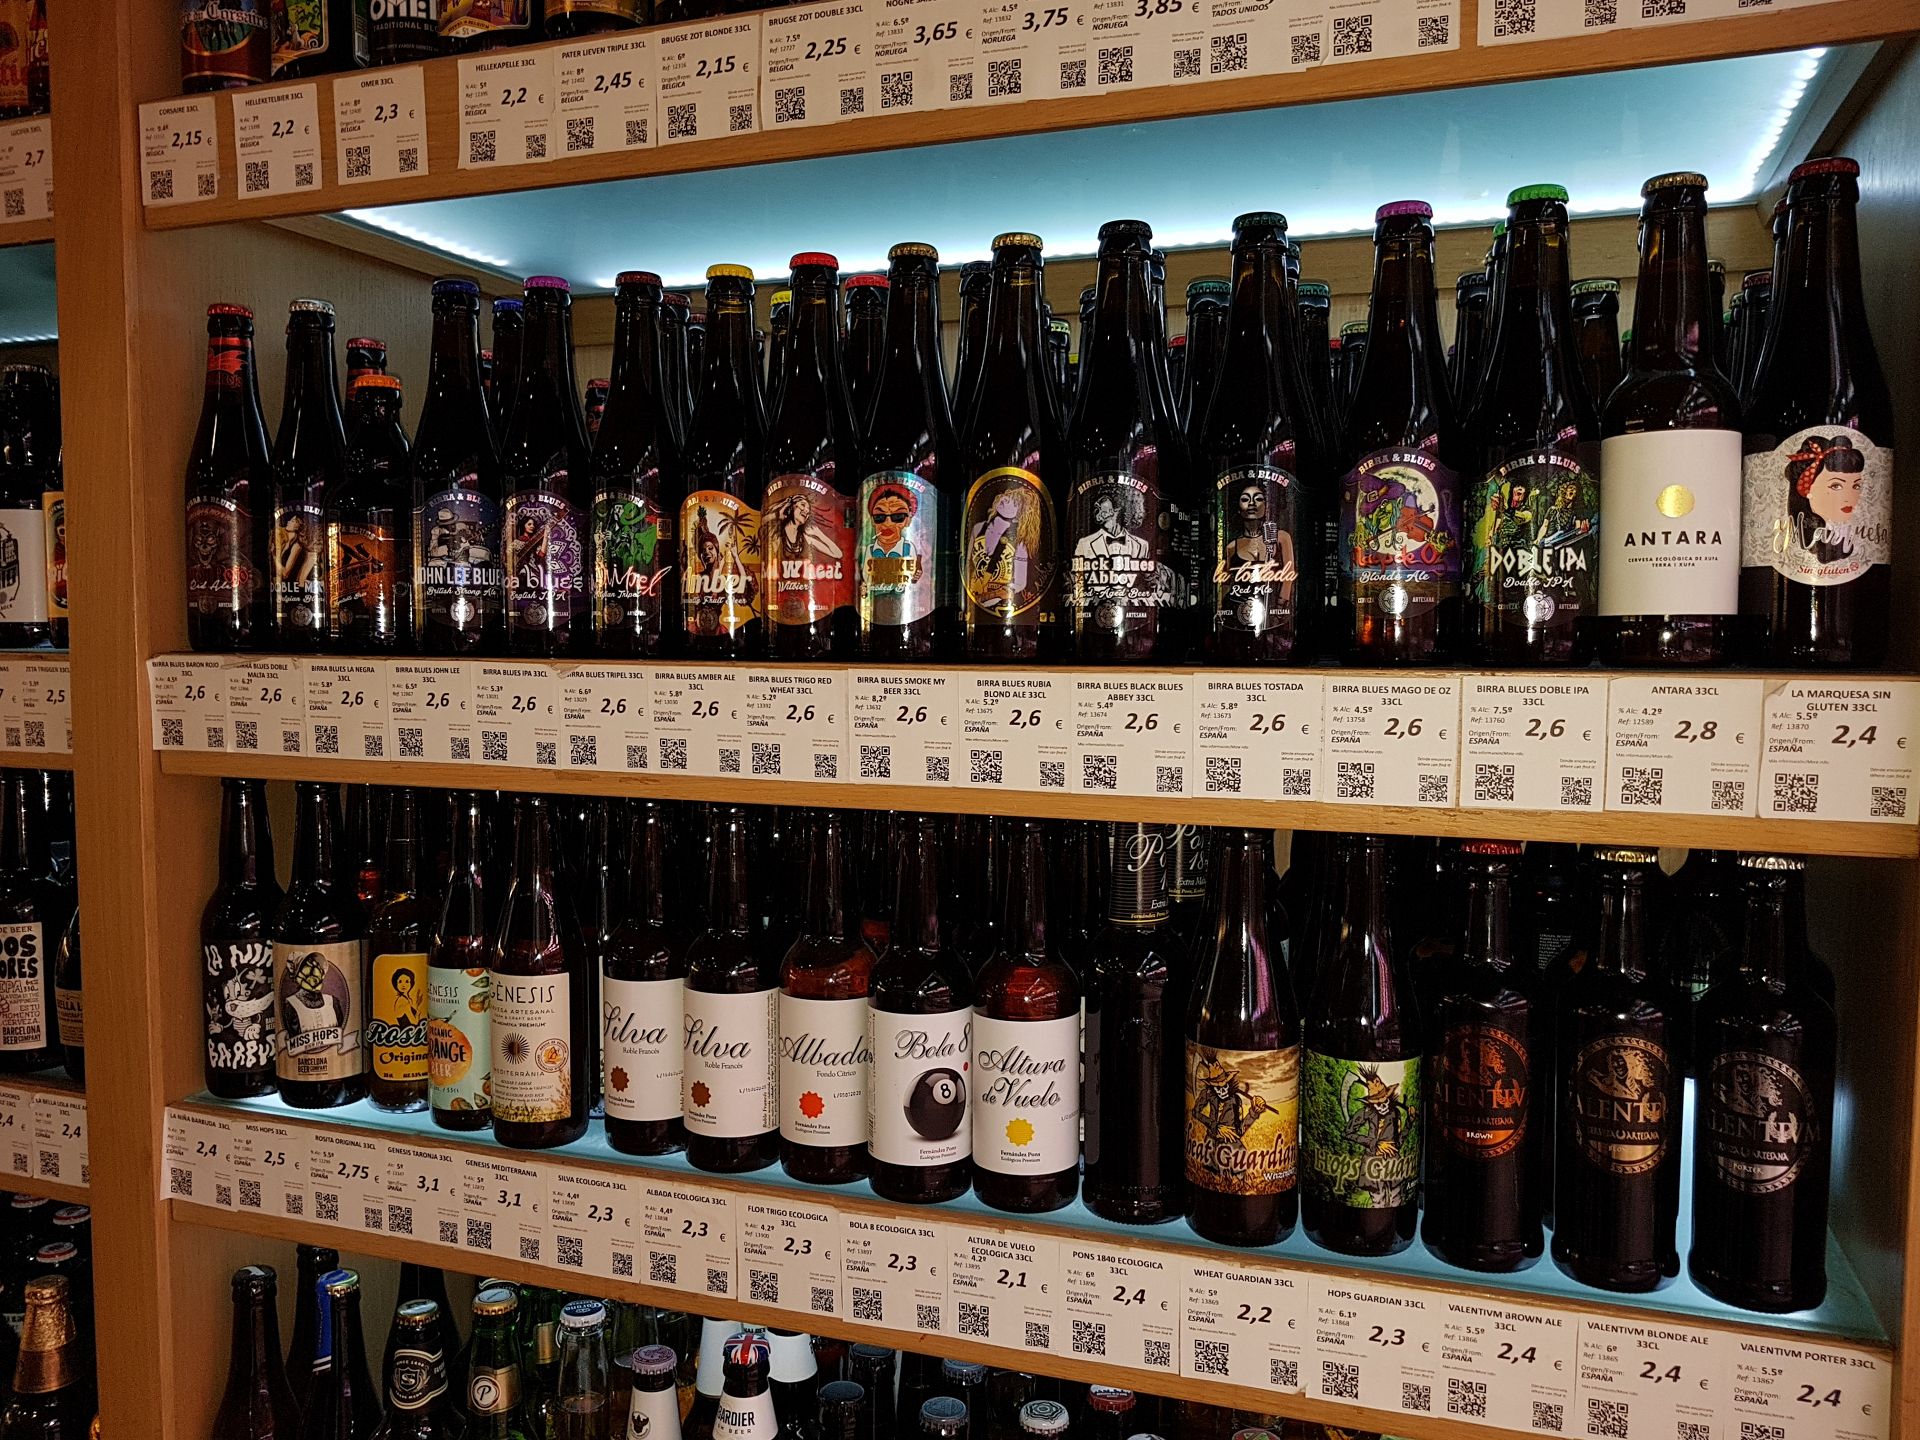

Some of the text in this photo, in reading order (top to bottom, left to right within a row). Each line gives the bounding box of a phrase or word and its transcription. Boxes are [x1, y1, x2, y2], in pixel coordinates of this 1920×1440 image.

[769, 5, 863, 26] BRUGSE ZOT DOUBLE 33CL
[1022, 8, 1068, 32] 3,75
[374, 21, 421, 32] TRADITIONAL
[661, 24, 751, 44] BRUGSE ZOT BLONDE 33CL
[913, 21, 958, 44] 3,65
[562, 41, 646, 59] PATER LIEVEN TRIPLE 33CL
[805, 37, 861, 61] 2,25 €
[875, 47, 908, 57] NORUEGA
[696, 56, 736, 78] 2,15
[361, 77, 394, 88] OMER 33CL
[594, 71, 632, 93] 2,45
[374, 104, 398, 121] 2,3
[172, 131, 202, 148] 2,15
[25, 150, 44, 167] 2,7
[1500, 454, 1581, 476] BIRRA & BLUES
[1077, 475, 1148, 495] BIRRA & BLUES
[1624, 531, 1722, 547] ANTARA
[1072, 556, 1154, 572] Black Blues
[1490, 545, 1587, 576] DOBLE IPA
[782, 561, 842, 580] Wheat
[1359, 571, 1430, 582] Blonde Ale
[1797, 566, 1849, 577] Sin gluten
[483, 668, 501, 676] BIRRA
[534, 670, 548, 678] 33CL
[881, 677, 902, 685] BLUES
[904, 677, 929, 685] SMOKE
[931, 678, 945, 686] MY
[903, 688, 921, 696] 33CL
[1077, 682, 1183, 692] BIRRA BLUES BLACK BLUES
[1208, 683, 1303, 692] BIRRA BLUES TOSTADA
[1391, 686, 1451, 695] MAGO DE OZ
[1651, 686, 1719, 696] ANTARA 33CL
[1791, 690, 1891, 700] LA MARQUESA SIN
[46, 689, 65, 704] 2,5
[512, 696, 536, 712] 2,6
[1108, 693, 1155, 702] ABBEY 33CL
[1220, 702, 1238, 710] 5.8º
[1641, 706, 1662, 716] 4.2º
[1806, 702, 1878, 712] GLUTEN 33CL
[1124, 713, 1158, 733] 2,6
[1485, 716, 1505, 724] 13760
[1200, 731, 1228, 739] ESPAÑA
[1525, 718, 1591, 741] 2,6 €
[1674, 720, 1717, 743] 2,8
[1831, 725, 1878, 747] 2,4
[1615, 738, 1648, 748] ESPAÑA
[3, 1025, 40, 1035] BARCELONA
[603, 1001, 668, 1044] Silva
[289, 1029, 339, 1049] MISS HOPS
[684, 1013, 751, 1059] Silva
[895, 1022, 971, 1059] Bola 8
[623, 1047, 641, 1055] Roble
[779, 1033, 869, 1066] Albada
[978, 1046, 1065, 1074] Altura
[941, 1083, 951, 1098] 8
[982, 1077, 1060, 1107] de Vuelo
[246, 1124, 288, 1136] MISS HOPS 33CL
[1466, 1131, 1493, 1140] BROWN
[315, 1134, 376, 1150] ROSITA ORIGINAL 33CL
[264, 1150, 286, 1166] 2,5
[1314, 1149, 1359, 1193] Hops
[1733, 1164, 1764, 1175] PORTER
[558, 1175, 627, 1191] SILVA ECOLOGICA 33CL
[588, 1204, 613, 1222] 2,3
[850, 1221, 867, 1230] BOLA
[876, 1225, 916, 1236] ECOLOGICA
[918, 1230, 935, 1238] 33CL
[968, 1236, 1035, 1252] ALTURA DE VUELO
[1072, 1251, 1163, 1270] PONS 1840 ECOLOGICA
[997, 1269, 1027, 1288] 2,1
[1194, 1269, 1294, 1288] WHEAT GUARDIAN 33CL
[1112, 1285, 1146, 1306] 2,4
[1740, 1343, 1876, 1370] VALENTIVM PORTER 33CL
[1796, 1384, 1841, 1408] 2,4
